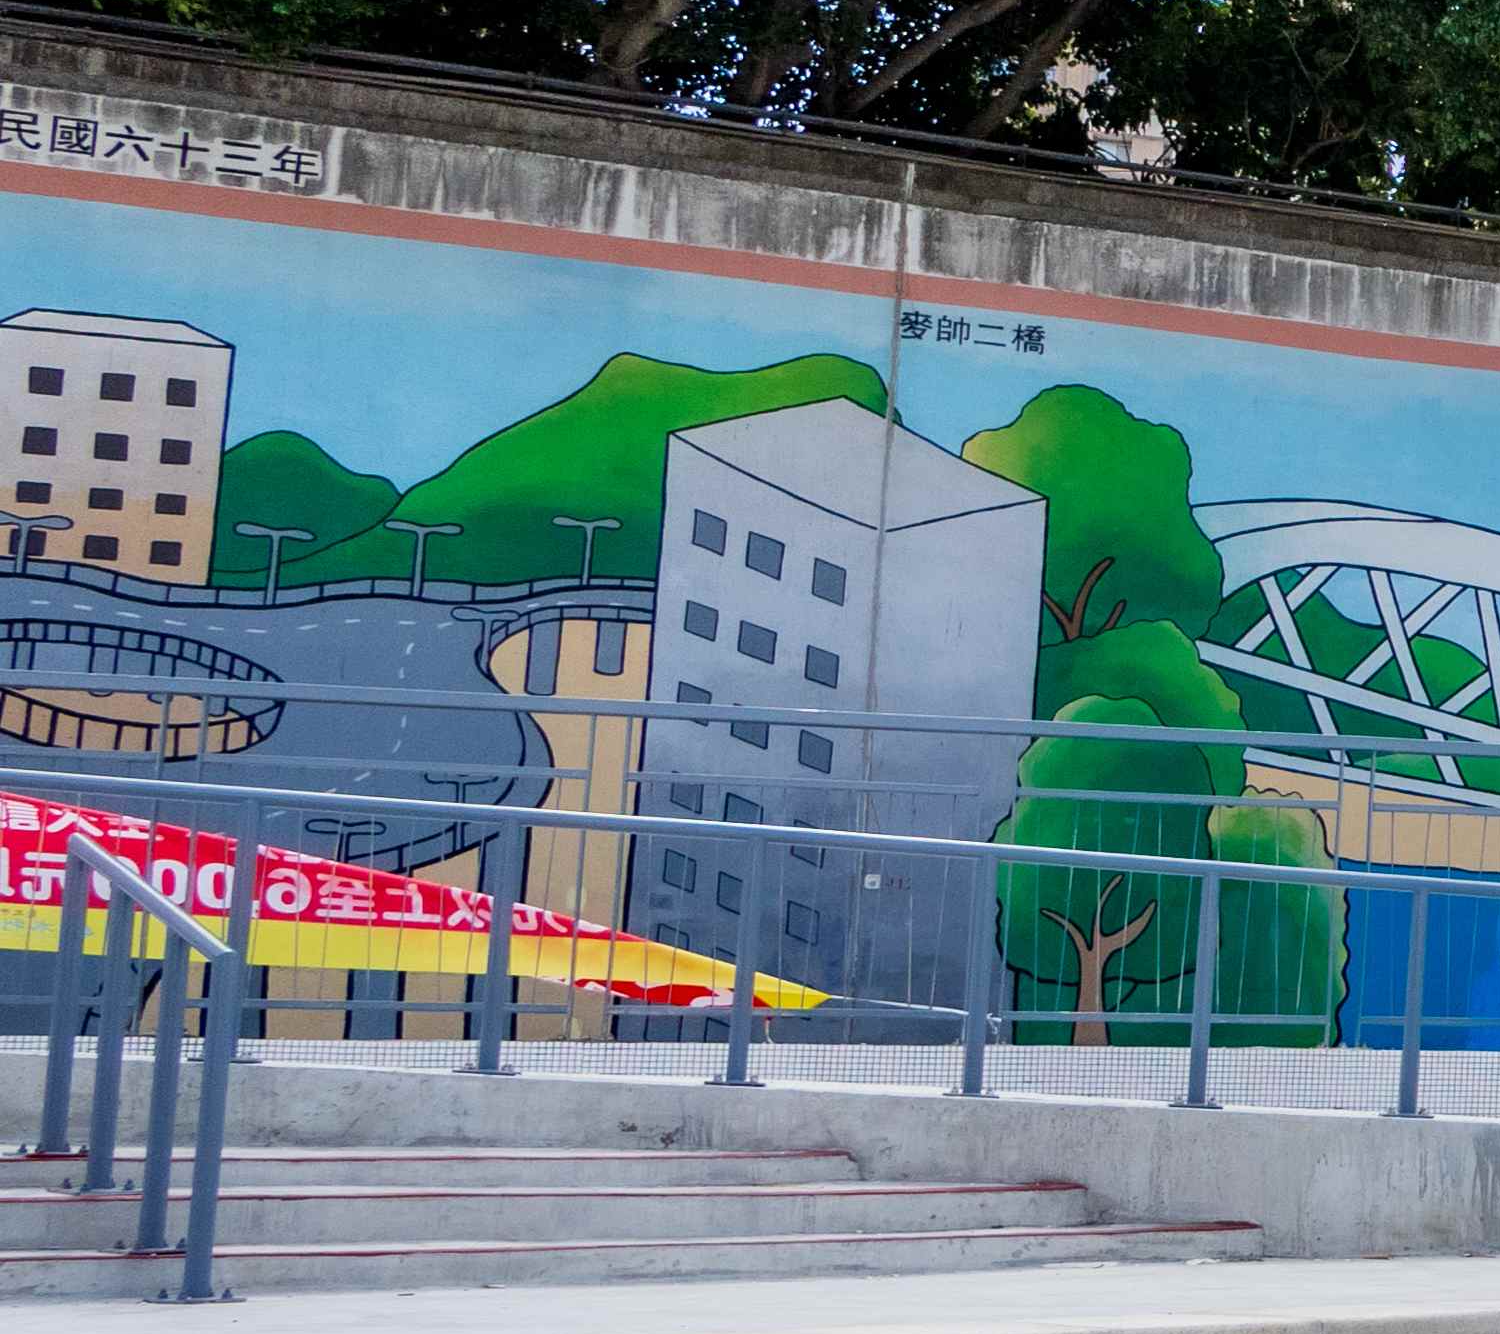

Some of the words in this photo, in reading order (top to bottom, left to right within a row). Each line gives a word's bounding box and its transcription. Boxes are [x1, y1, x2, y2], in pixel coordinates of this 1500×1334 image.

[0, 109, 319, 184] 民國六十三年
[900, 311, 1045, 355] 麥帥二橋
